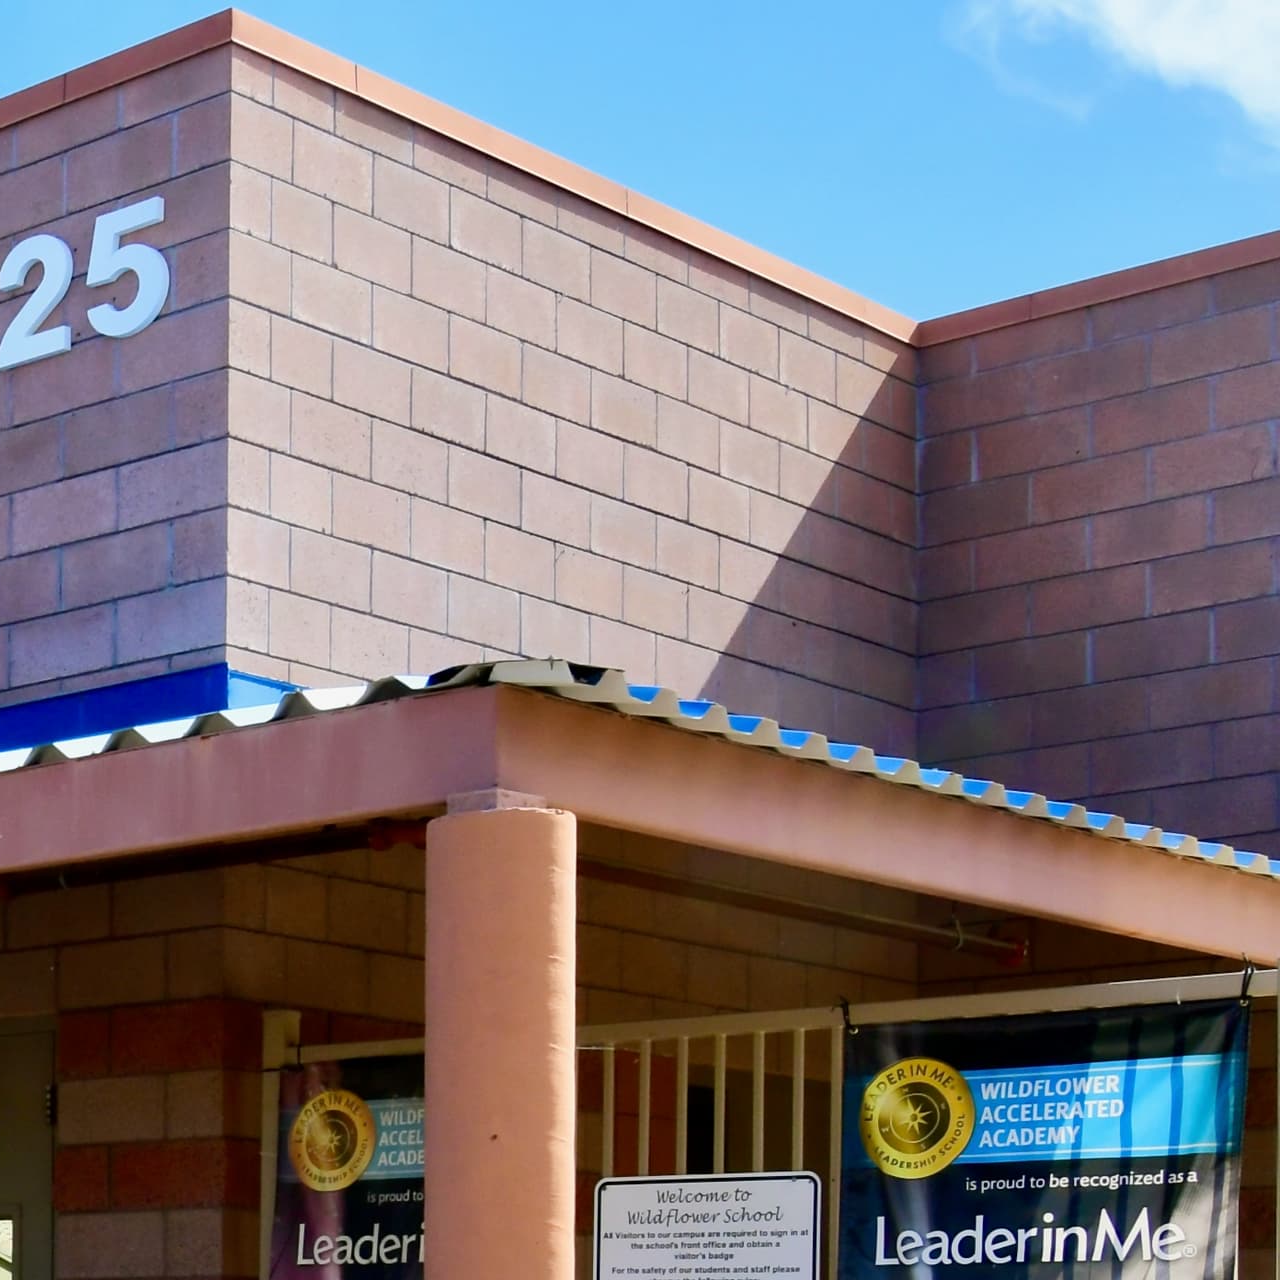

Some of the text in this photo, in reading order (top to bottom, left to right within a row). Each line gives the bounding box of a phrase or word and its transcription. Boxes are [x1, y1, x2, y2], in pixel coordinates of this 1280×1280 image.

[864, 1068, 906, 1122] LEADER
[910, 1064, 927, 1077] IN
[980, 1074, 1121, 1100] WILDFLOWER
[379, 1109, 424, 1126] WILDF
[979, 1099, 1124, 1124] ACCELERATED
[379, 1129, 424, 1146] ACCEL
[874, 1113, 966, 1169] LEADERSHIP SCHOOL
[978, 1125, 1080, 1148] ACADEMY
[377, 1150, 424, 1166] ACADE
[965, 1169, 1198, 1194] is proud to be recognized as a
[367, 1189, 424, 1206] is proud to
[657, 1187, 752, 1204] Welcome to
[627, 1205, 783, 1227] Wildflower School
[673, 1231, 705, 1239] campus
[723, 1230, 757, 1238] required
[770, 1229, 788, 1238] sign
[297, 1223, 424, 1265] Leaderi
[708, 1252, 734, 1261] badge
[641, 1267, 666, 1275] safety
[668, 1266, 677, 1274] of
[750, 1265, 771, 1273] staff
[772, 1266, 800, 1274] please
